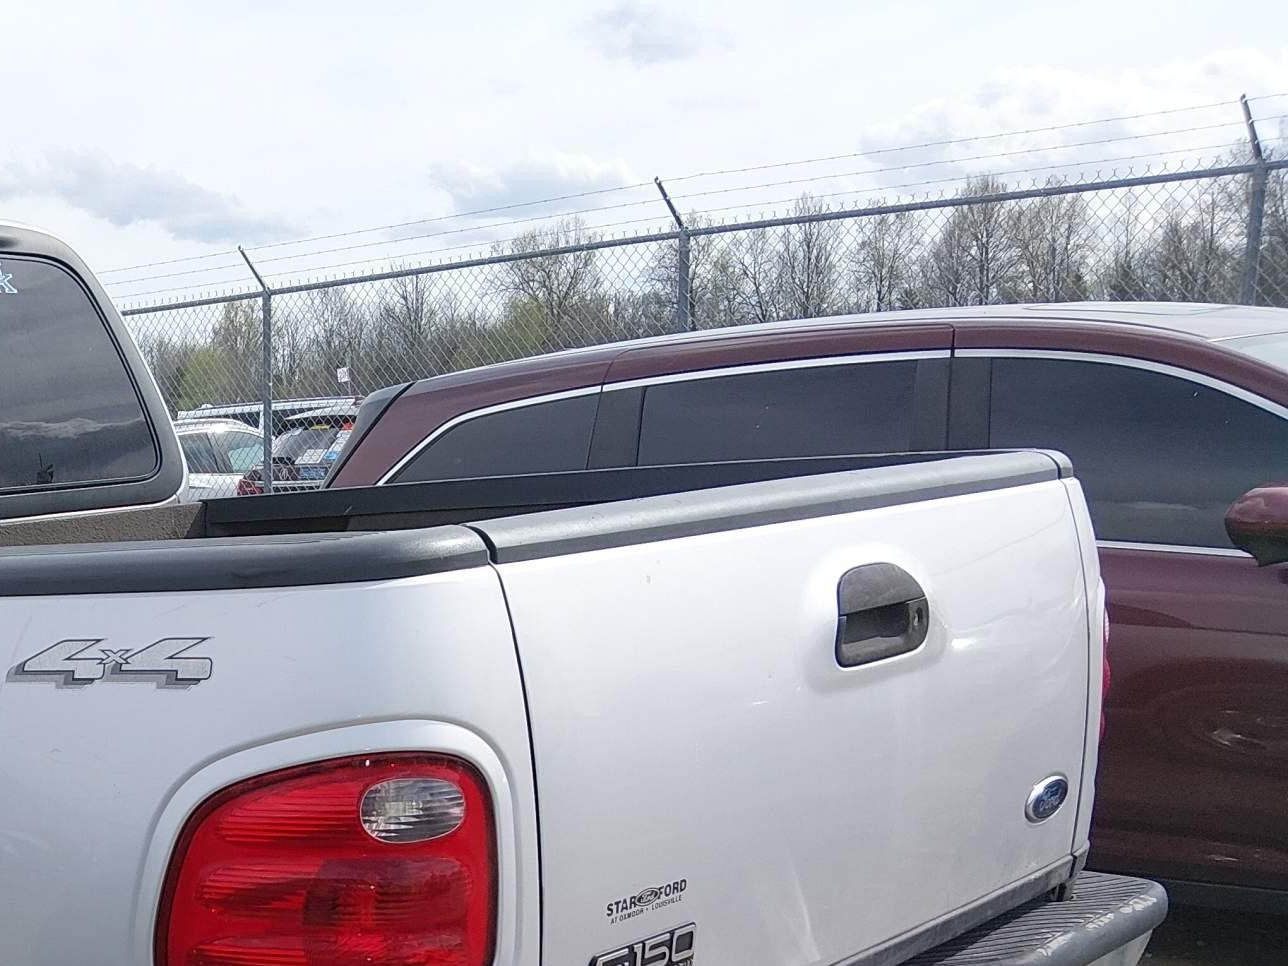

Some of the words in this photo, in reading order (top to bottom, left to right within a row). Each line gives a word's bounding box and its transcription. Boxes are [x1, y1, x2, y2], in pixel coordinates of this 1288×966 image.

[606, 895, 638, 917] STAR
[657, 879, 687, 899] FORD
[652, 894, 682, 911] LOUISVILLE
